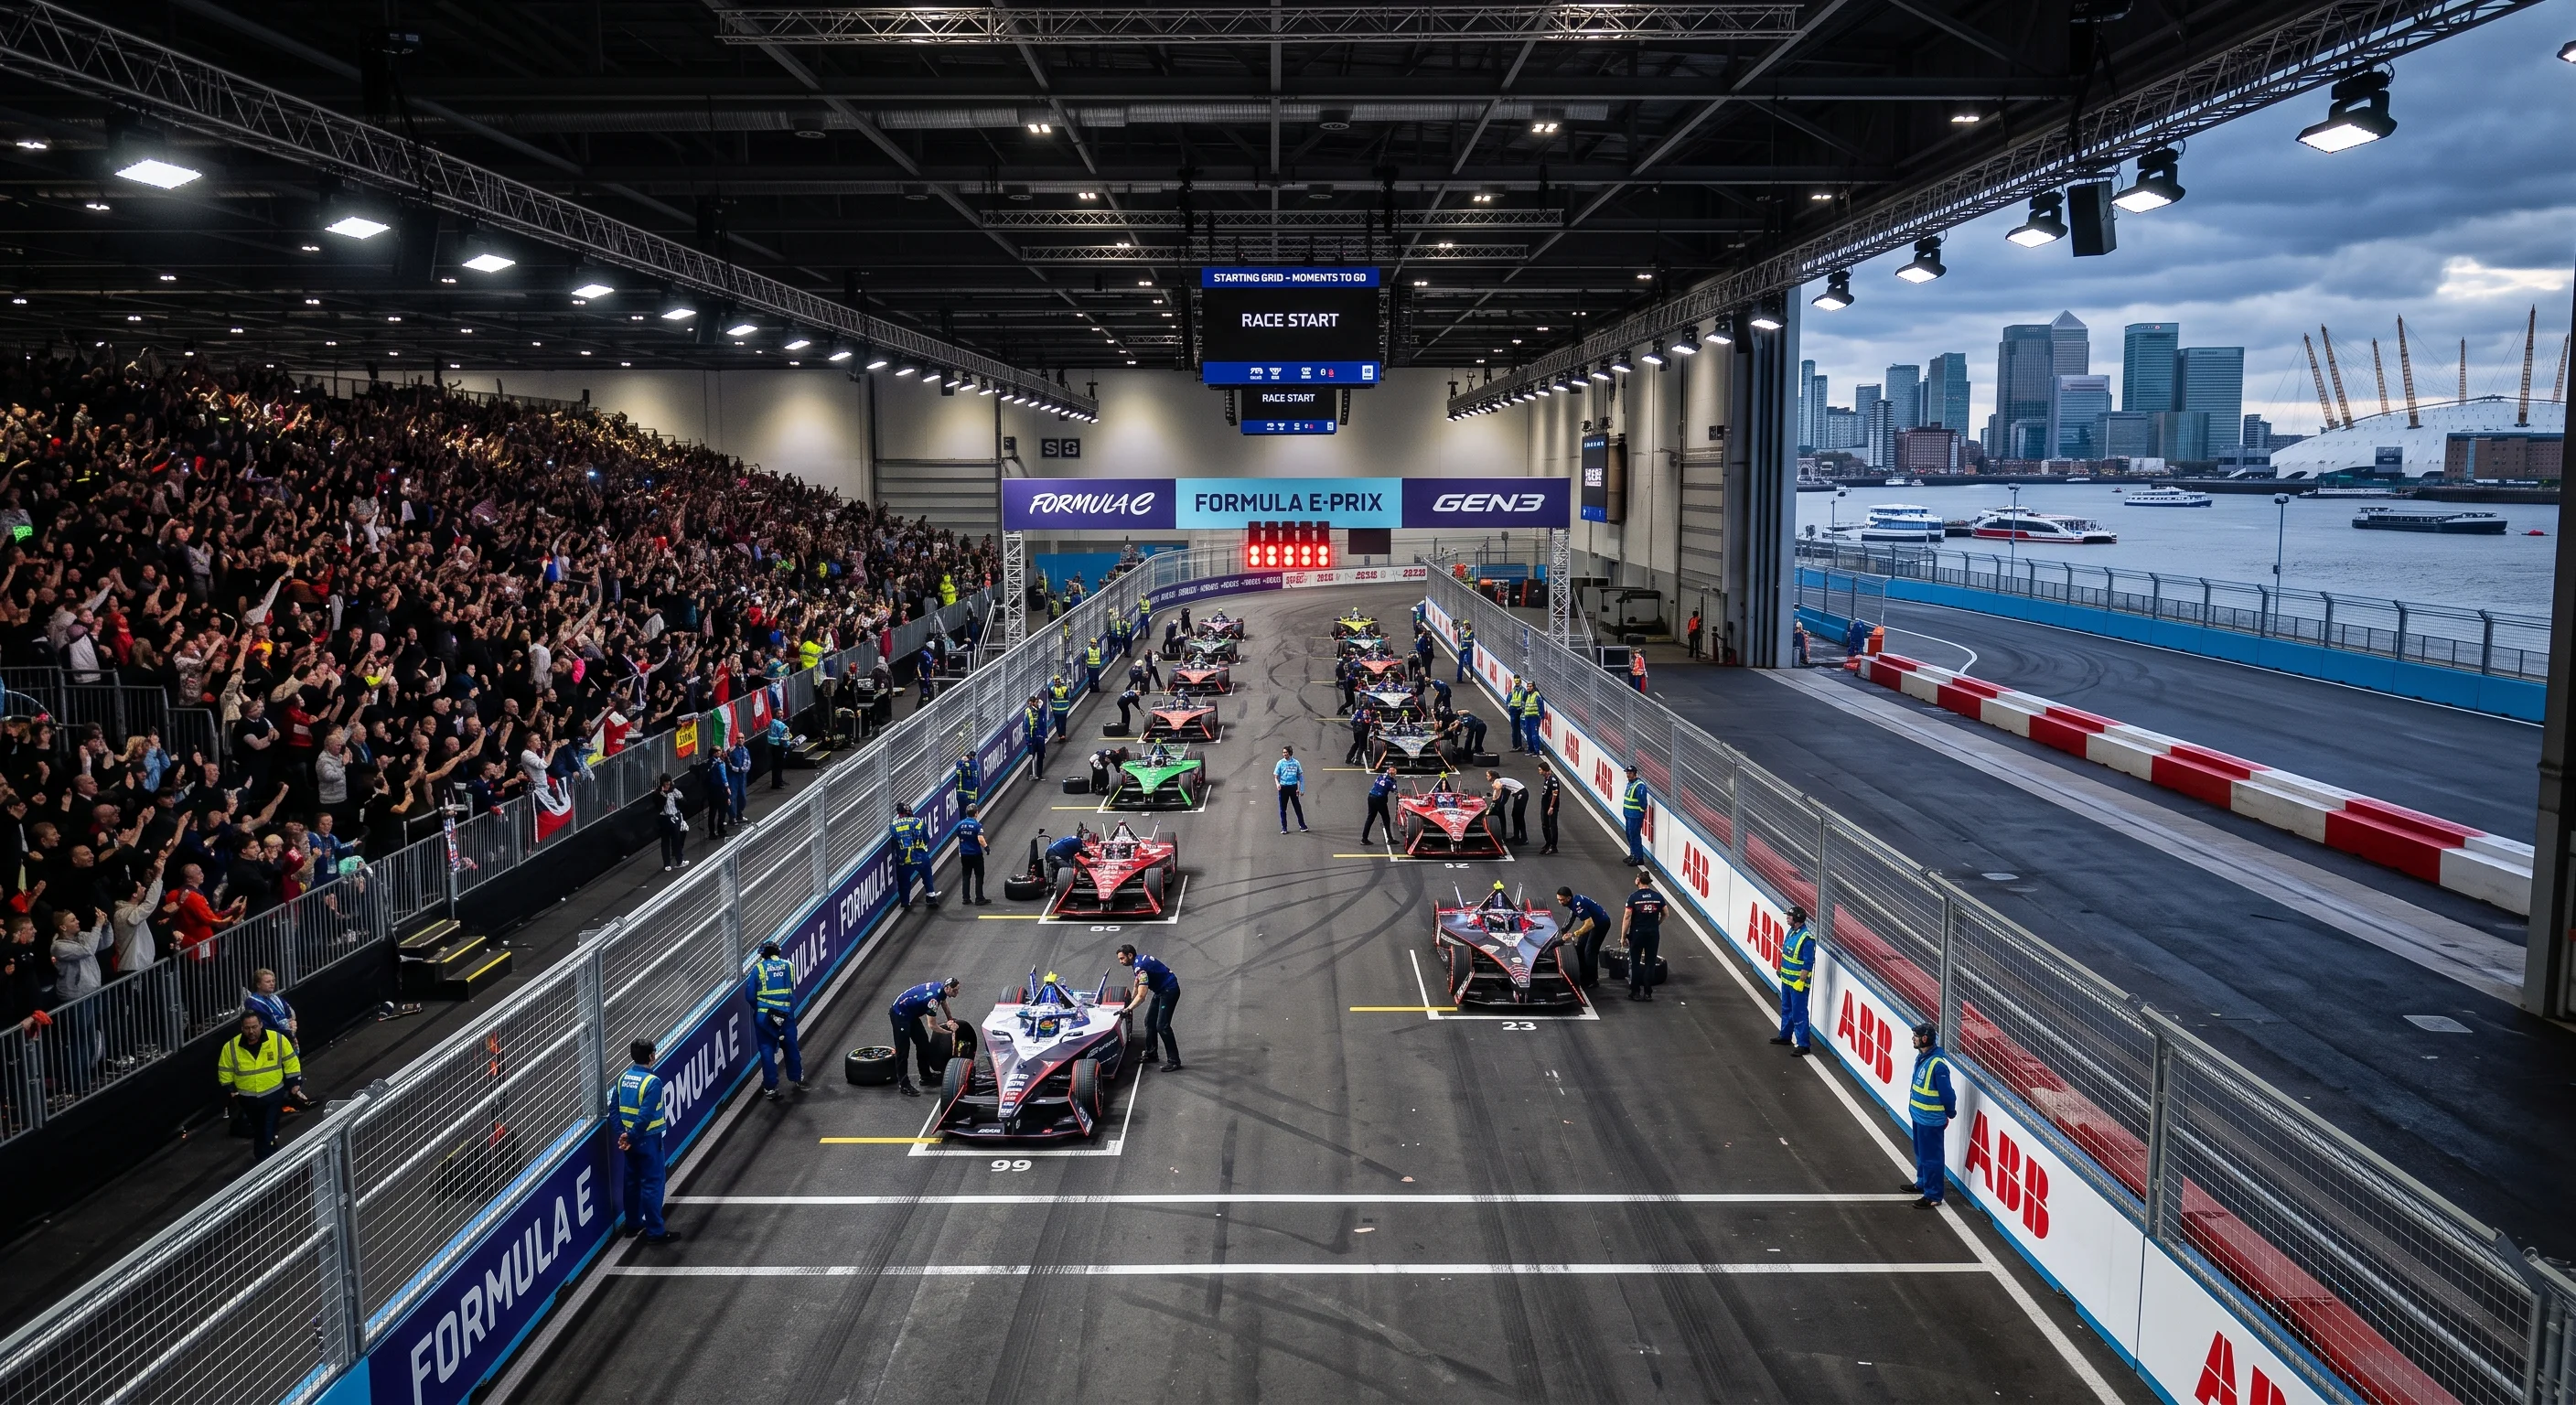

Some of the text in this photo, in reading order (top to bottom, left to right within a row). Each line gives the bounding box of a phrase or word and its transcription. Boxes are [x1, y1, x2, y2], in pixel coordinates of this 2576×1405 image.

[1214, 273, 1260, 282] STARTING
[1261, 273, 1283, 282] GRID
[1292, 273, 1337, 282] MOMENTS
[1339, 273, 1352, 282] TO
[1241, 314, 1339, 327] RACE START
[1261, 394, 1315, 402] RACE START
[1029, 492, 1129, 515] FORMULA
[1195, 492, 1383, 512] FORMULA E-PRIX
[1432, 493, 1546, 512] GEN3
[1681, 841, 1709, 898] ABB
[840, 853, 894, 937] FORMULA E
[820, 919, 827, 961] E
[1746, 901, 1785, 971] ABB
[1501, 1021, 1537, 1031] 23
[1837, 989, 1894, 1085] ABB
[662, 1012, 739, 1137] RMULA E
[991, 1159, 1032, 1172] 99
[1965, 1109, 2050, 1240] ABB
[411, 1165, 595, 1405] FORMULA E
